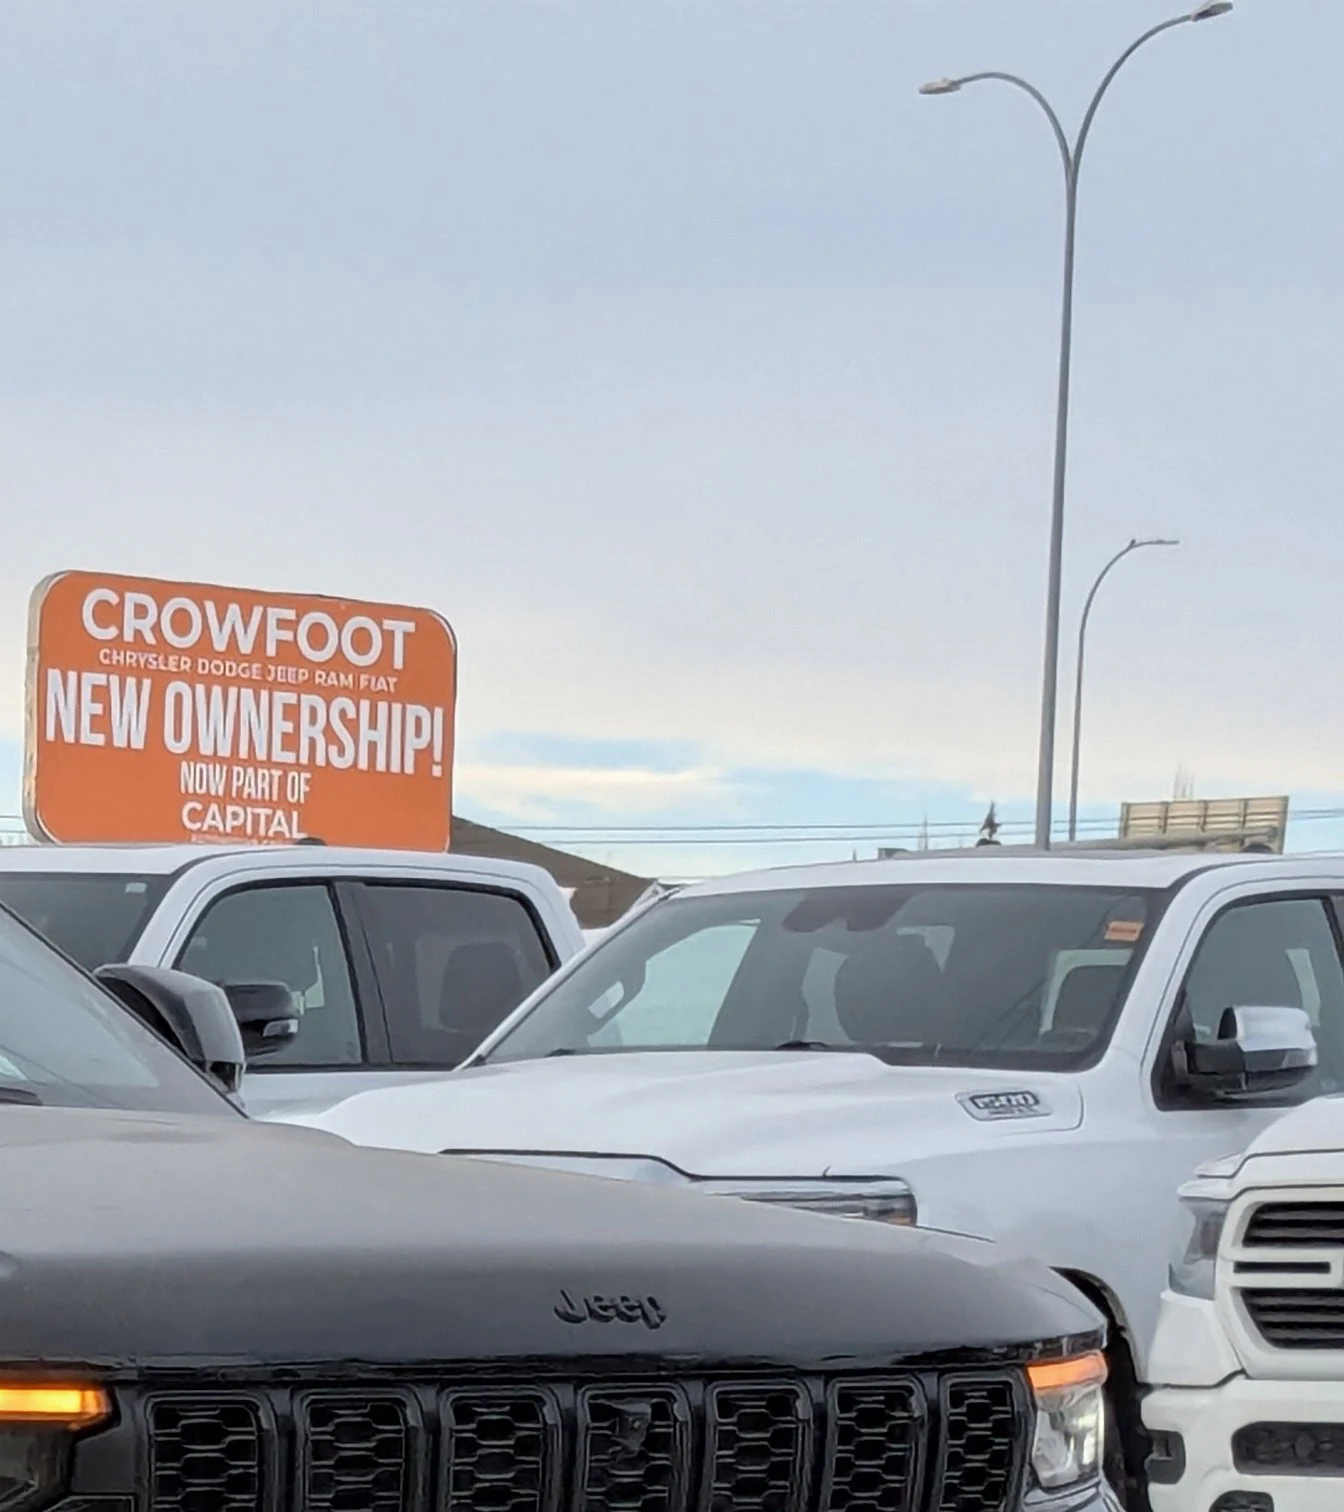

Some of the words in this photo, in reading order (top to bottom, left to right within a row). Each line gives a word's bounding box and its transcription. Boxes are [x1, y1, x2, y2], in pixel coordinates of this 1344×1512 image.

[82, 588, 415, 670] CROWFOOT
[99, 648, 192, 672] CHRYSLER
[197, 658, 262, 681] DODGE
[267, 664, 309, 685] JEEP
[315, 670, 354, 690] RAM
[359, 674, 399, 694] FIAT
[46, 668, 152, 750] NEW
[164, 680, 444, 778] OWNERSHIP!
[180, 760, 228, 798] NOW
[231, 765, 284, 801] PART
[286, 770, 311, 804] OF
[181, 801, 309, 839] CAPITAL
[553, 1287, 668, 1331] Jeep
